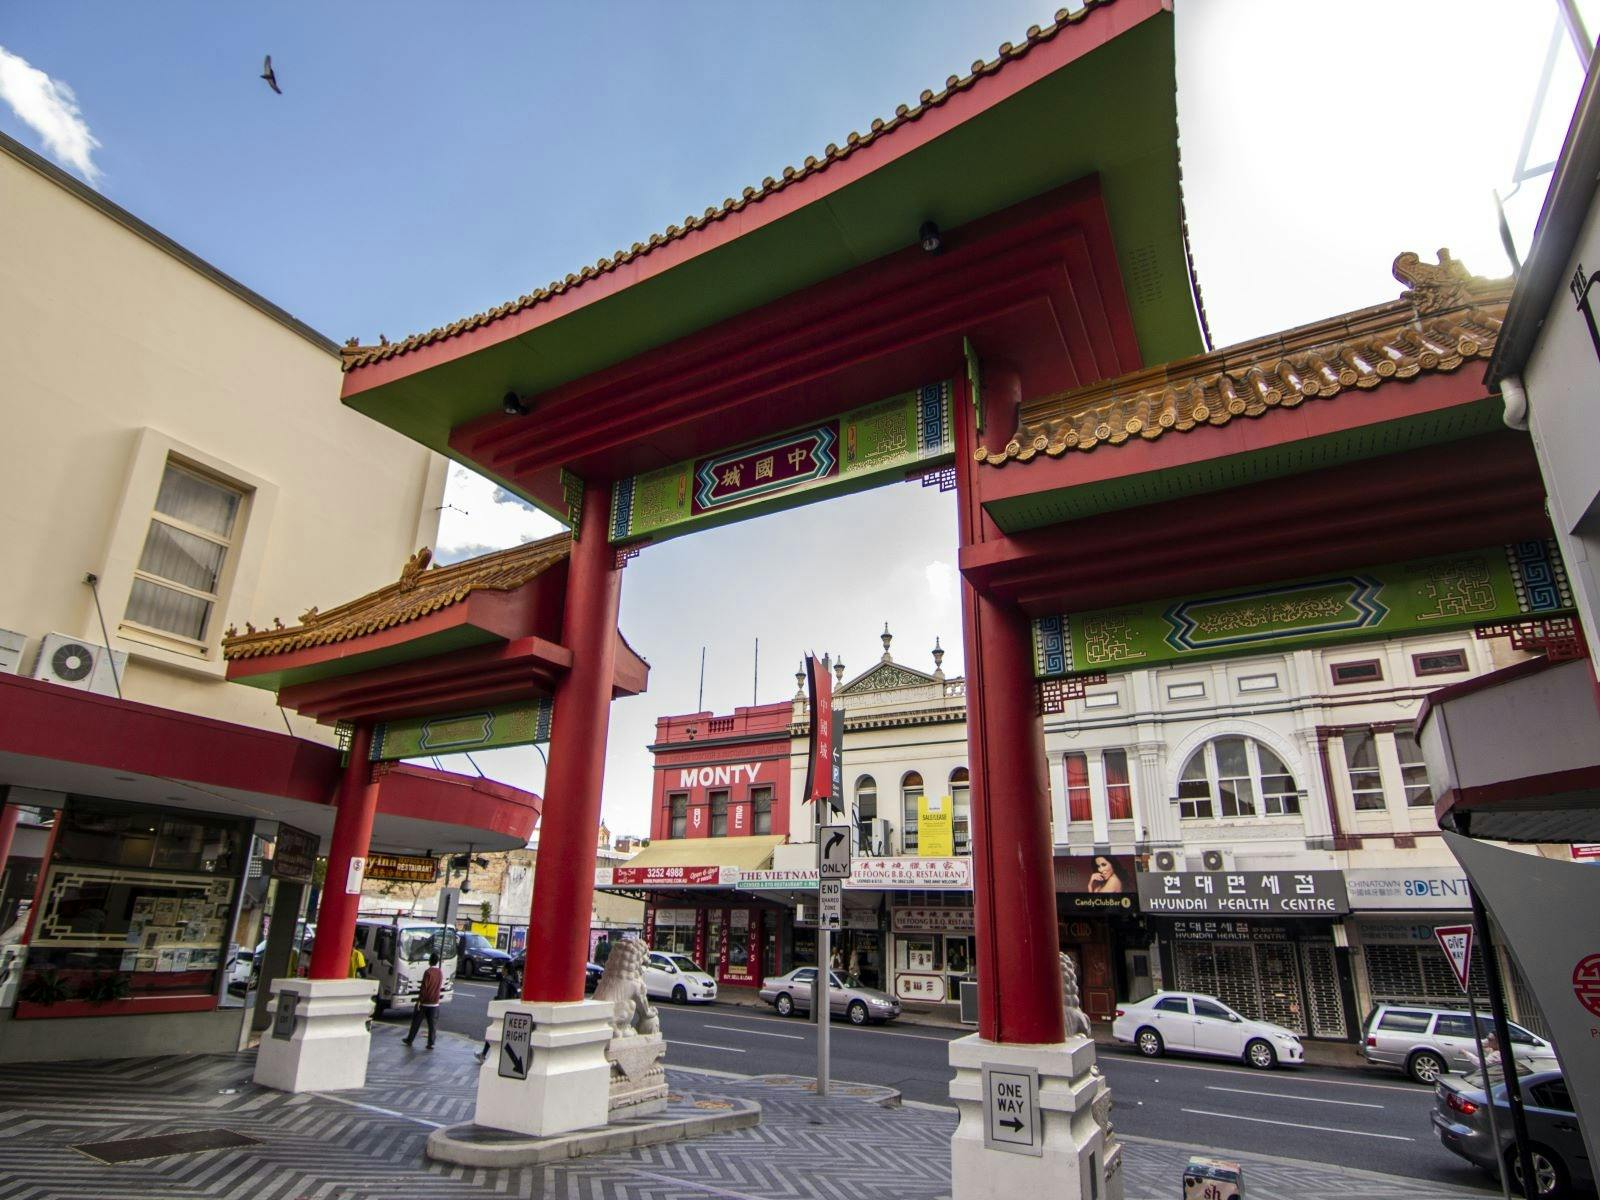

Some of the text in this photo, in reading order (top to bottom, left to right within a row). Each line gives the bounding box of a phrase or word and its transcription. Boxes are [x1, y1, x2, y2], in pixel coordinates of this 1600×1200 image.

[680, 763, 762, 788] MONTY
[735, 805, 743, 829] SELL
[397, 863, 433, 873] RESTAURANT
[647, 868, 664, 877] 3252
[822, 864, 848, 873] ONLY
[739, 871, 761, 880] THE
[863, 870, 890, 878] FOONG
[916, 870, 966, 878] RESTAURANT
[1348, 880, 1401, 888] CHINATOWN
[821, 885, 839, 894] END
[1075, 899, 1120, 907] CandyClubBar
[1150, 899, 1336, 910] HYUNDAI HEALTH CENTRE
[721, 919, 729, 963] LOANS
[1448, 936, 1464, 949] GIVE
[1452, 951, 1464, 959] WAY
[508, 1019, 527, 1029] KEEP
[506, 1030, 527, 1042] RIGHT
[998, 1083, 1022, 1098] ONE
[998, 1099, 1024, 1113] WAY
